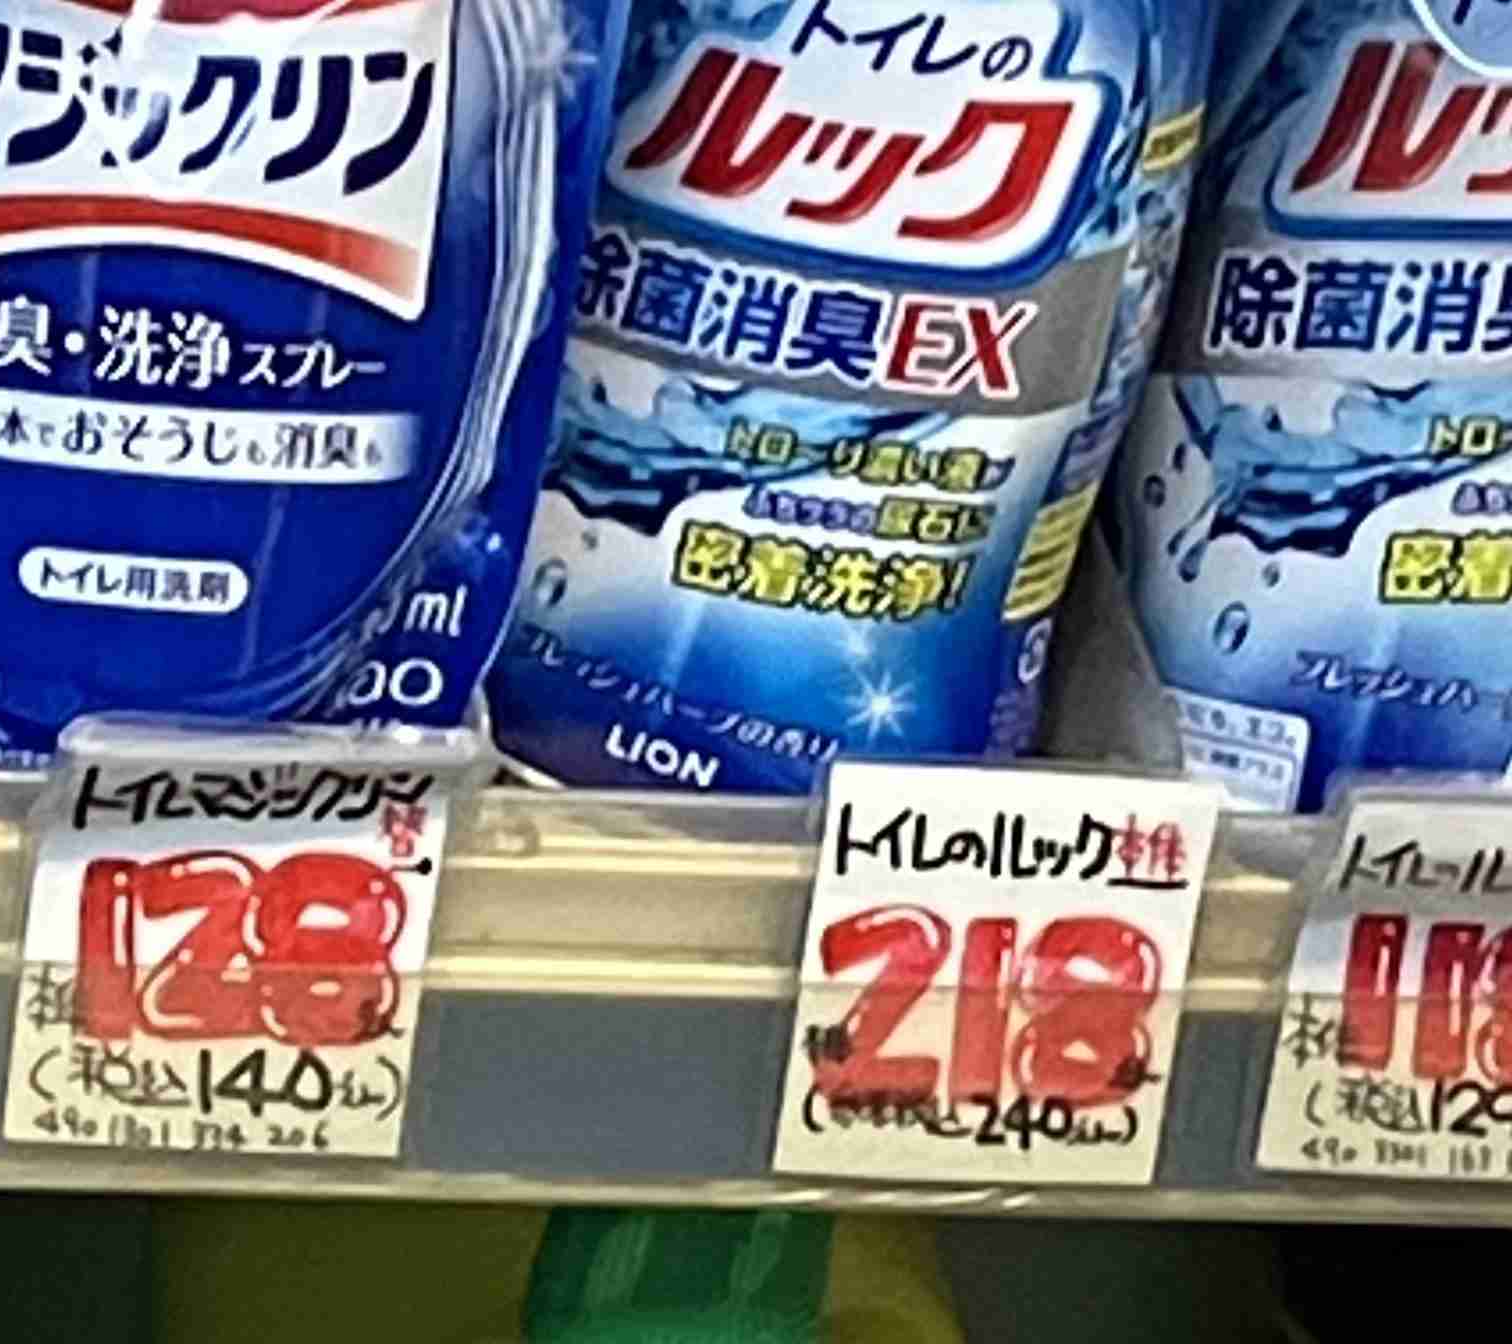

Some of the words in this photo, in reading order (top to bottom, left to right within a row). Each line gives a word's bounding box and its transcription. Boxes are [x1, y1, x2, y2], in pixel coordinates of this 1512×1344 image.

[791, 0, 1034, 80] トイレの
[624, 49, 1076, 241] ルック
[1208, 256, 1512, 353] 除菌消
[39, 555, 232, 604] トイレ用洗剤
[336, 656, 444, 707] ao
[606, 723, 720, 787] LION
[835, 802, 1114, 880] トイレのルック
[77, 850, 407, 1046] 128
[819, 905, 1163, 1104] 218
